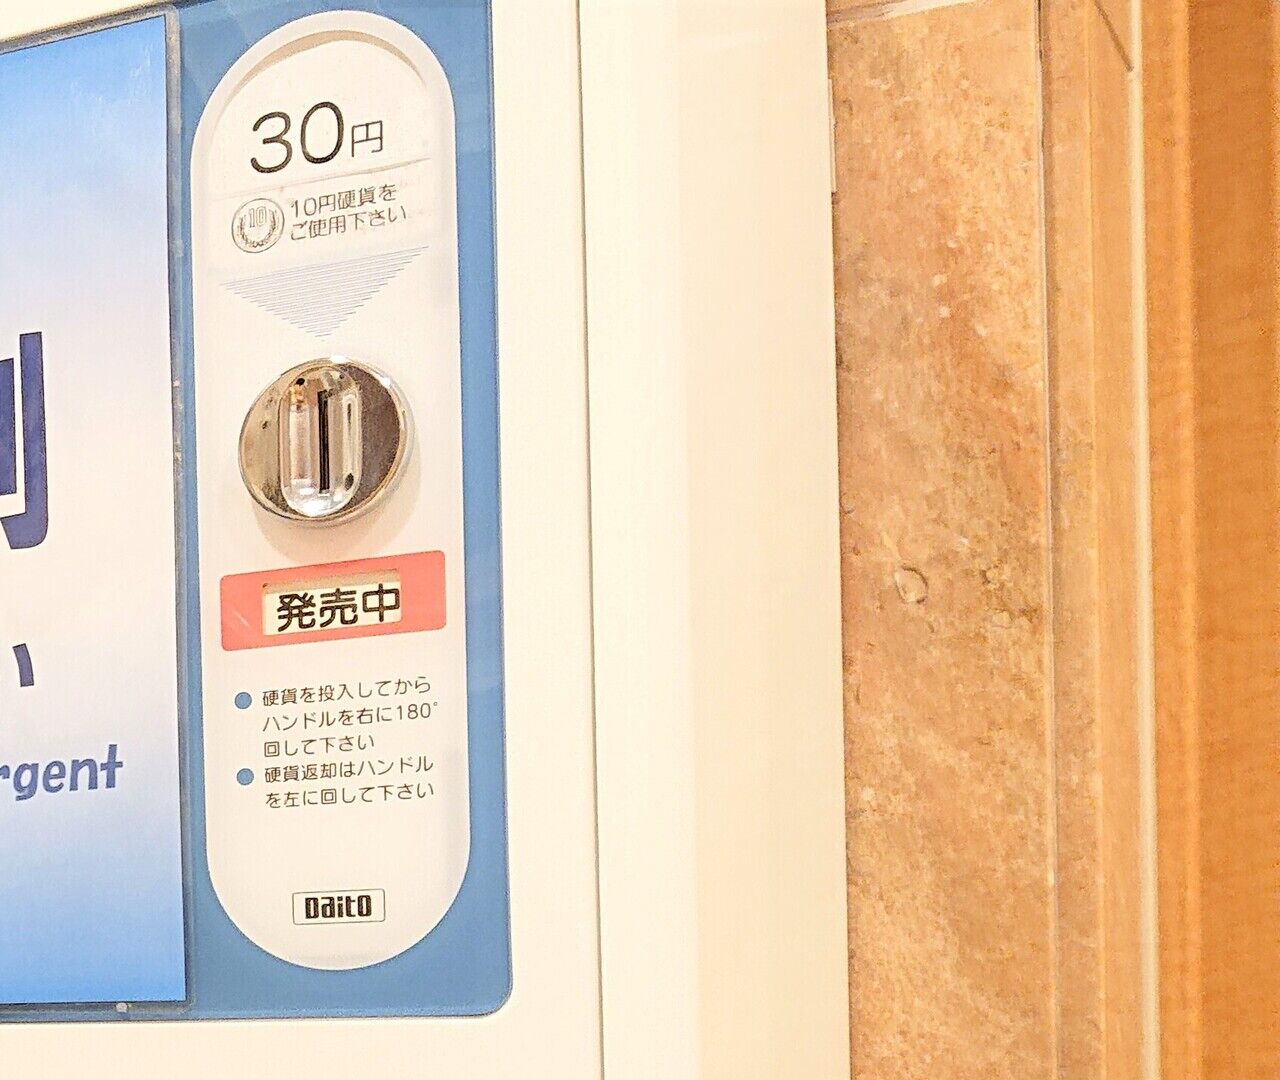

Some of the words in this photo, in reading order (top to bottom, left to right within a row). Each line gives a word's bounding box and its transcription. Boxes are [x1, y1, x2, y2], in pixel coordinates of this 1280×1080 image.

[251, 101, 383, 173] 30円
[290, 184, 396, 218] 10円硬貨を
[291, 205, 406, 240] ご使用下さい
[277, 583, 400, 632] 発売中
[262, 676, 431, 707] 硬貨を投入してから
[264, 735, 375, 758] 回して下さい
[265, 755, 433, 784] 硬貨返却はハンドル
[265, 782, 434, 809] を左に回して下さい
